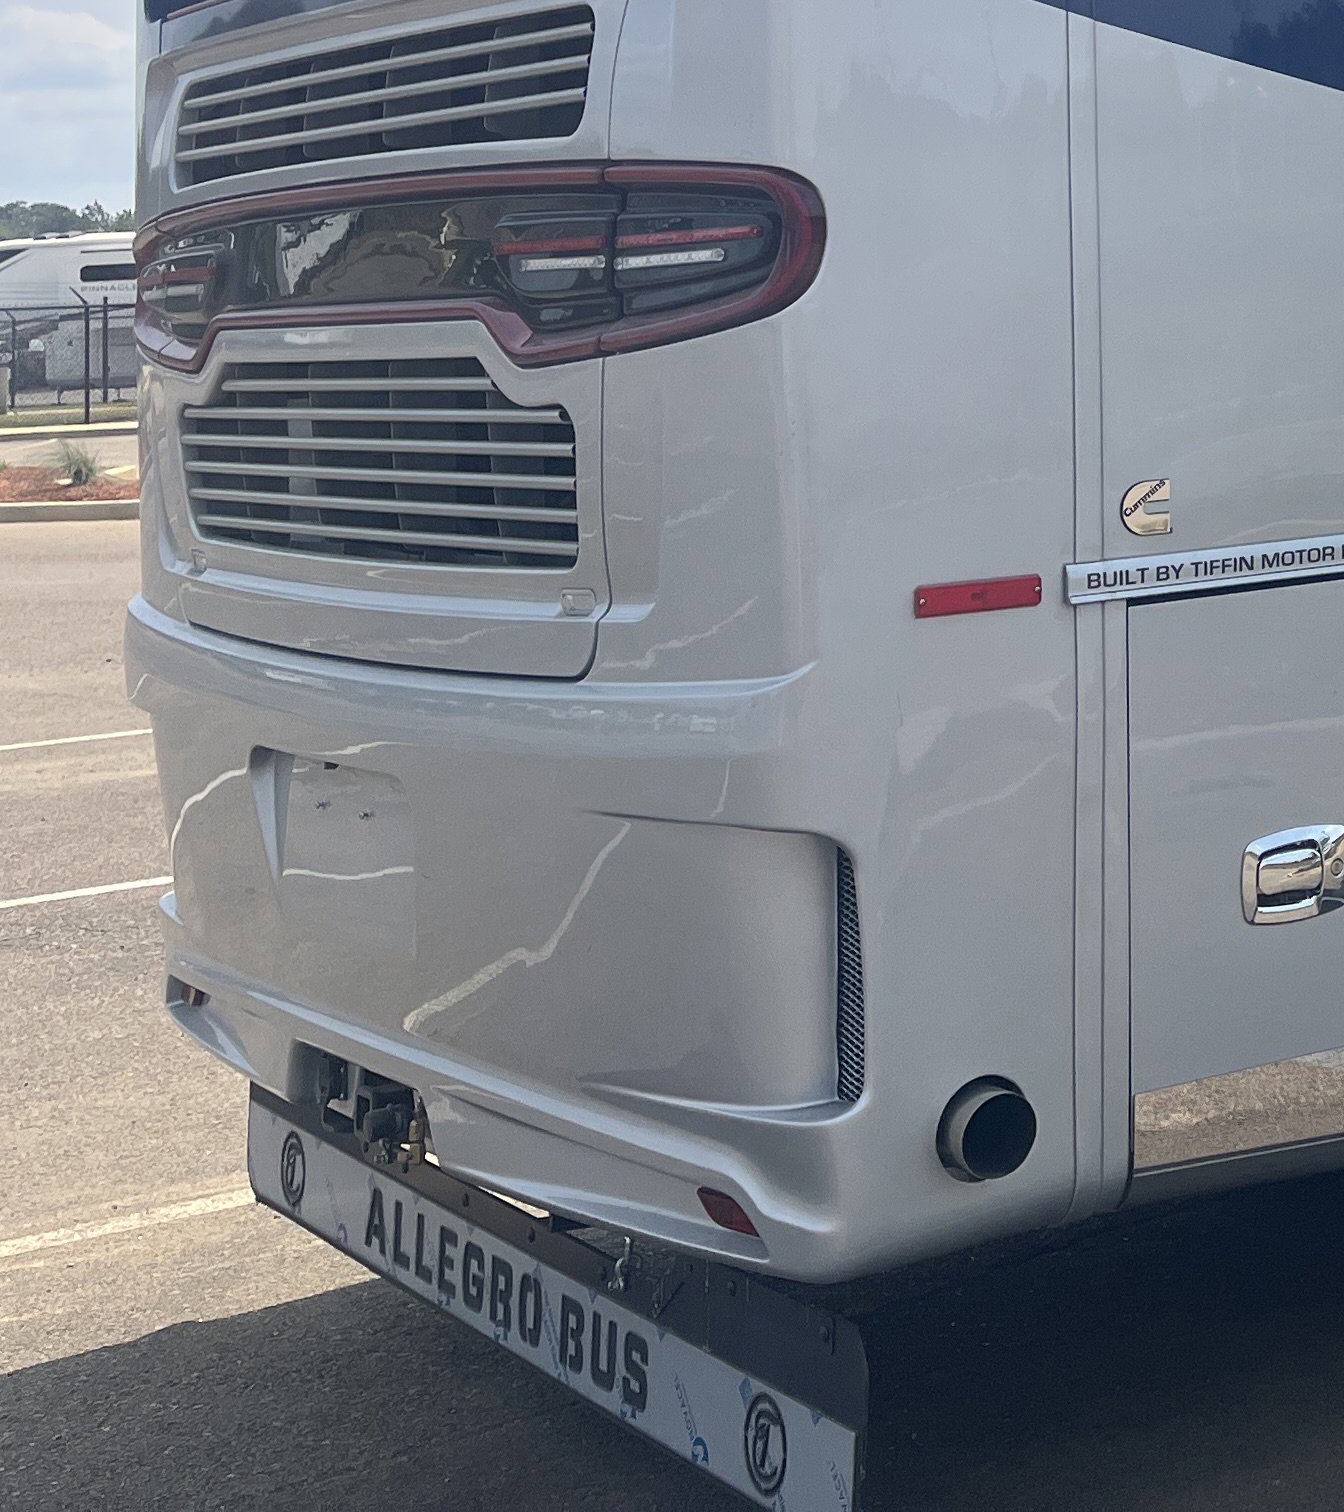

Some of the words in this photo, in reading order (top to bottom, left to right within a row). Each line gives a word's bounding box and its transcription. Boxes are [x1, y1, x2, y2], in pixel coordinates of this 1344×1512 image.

[1123, 479, 1166, 517] Cummins
[1087, 567, 1149, 589] BUILT
[1156, 563, 1184, 582] BY
[1190, 555, 1254, 577] TIFFIN
[1261, 546, 1334, 570] MOTOR
[364, 1187, 543, 1349] ALLEGRO
[559, 1293, 649, 1413] BUS
